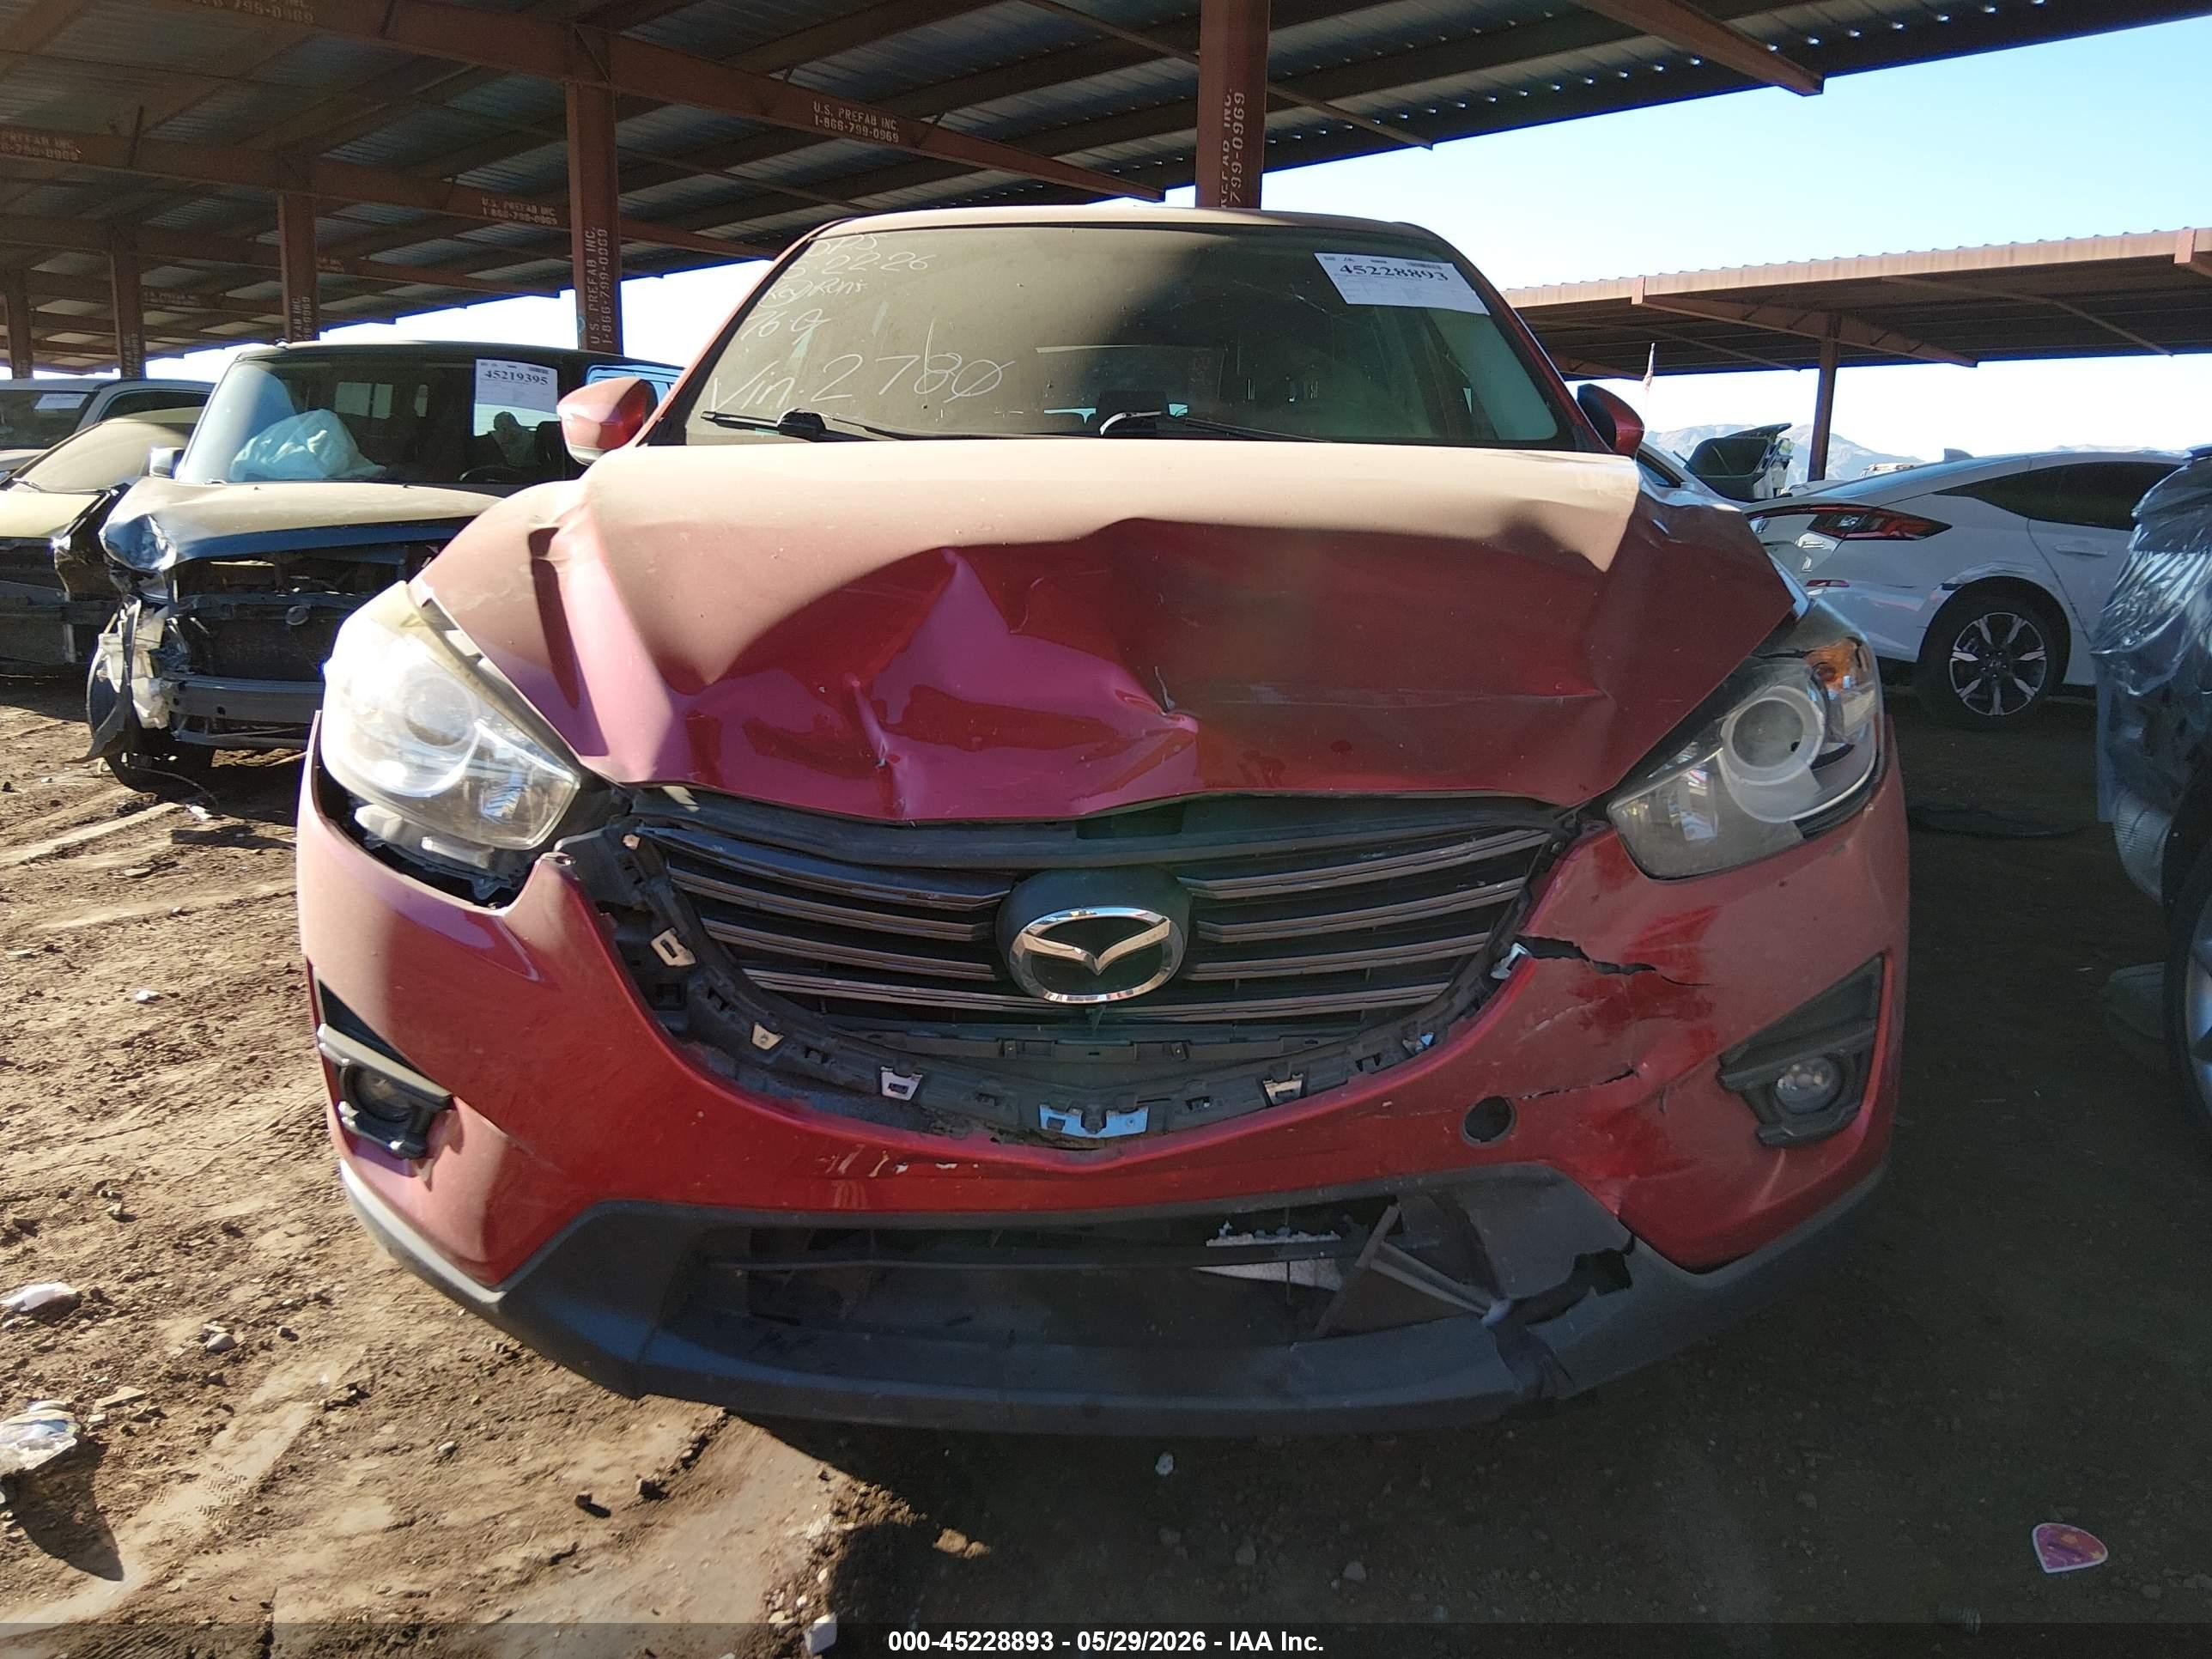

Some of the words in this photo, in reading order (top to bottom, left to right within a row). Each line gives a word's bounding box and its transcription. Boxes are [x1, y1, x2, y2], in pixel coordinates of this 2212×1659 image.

[813, 101, 833, 117] U.S.
[838, 108, 877, 125] PREFAB
[881, 118, 899, 132] INC.
[815, 115, 899, 143] 1-866-799-0969
[586, 259, 599, 311] PREFAB
[597, 228, 613, 344] 1-866-799-0969
[1340, 264, 1449, 282] 45228893
[484, 370, 549, 386] 45219395
